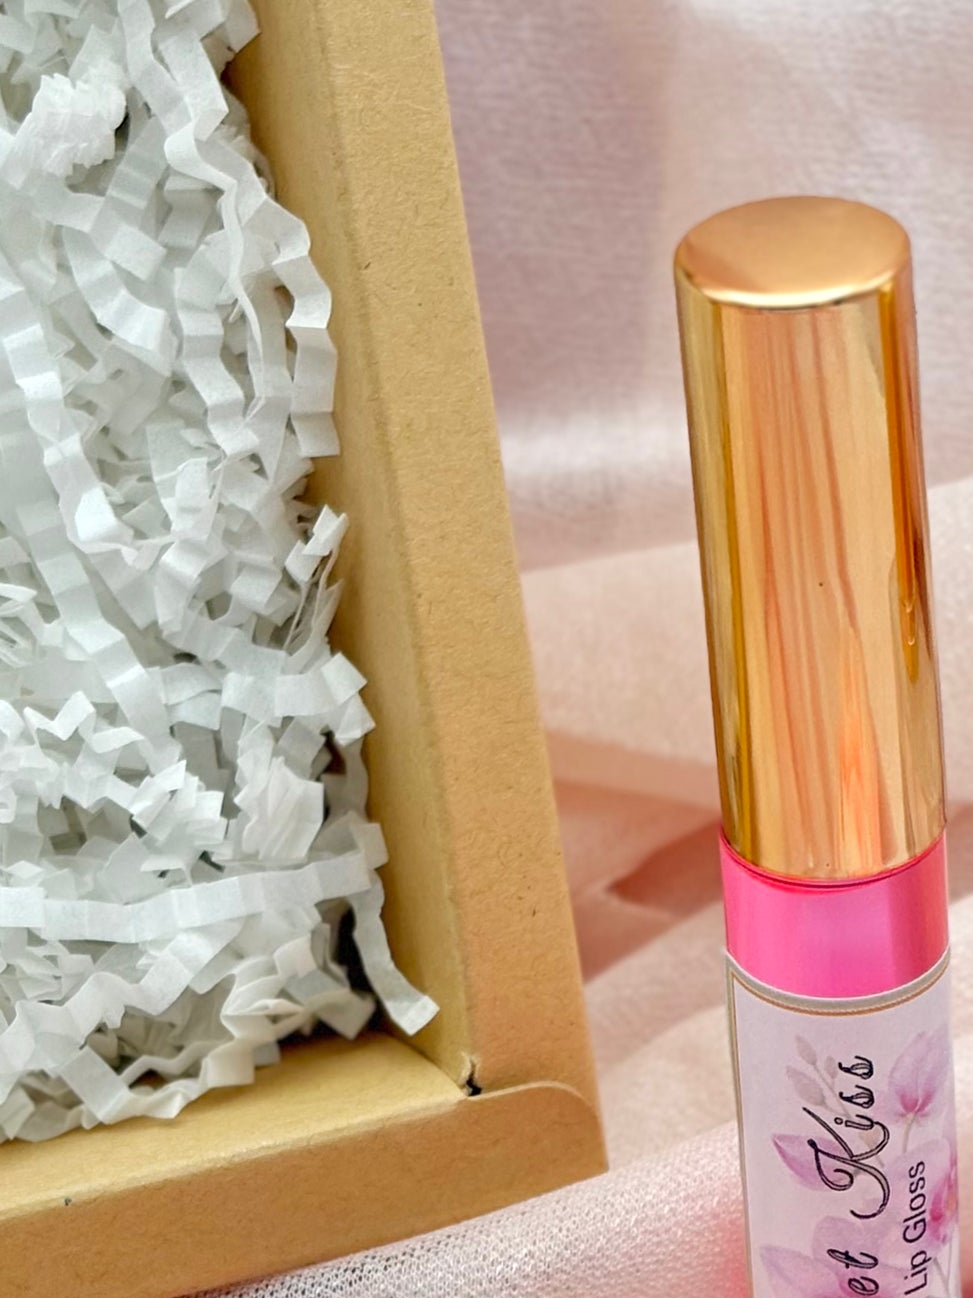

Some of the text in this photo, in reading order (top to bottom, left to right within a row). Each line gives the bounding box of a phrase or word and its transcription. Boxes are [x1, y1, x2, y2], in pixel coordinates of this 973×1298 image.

[802, 1055, 890, 1219] Kiss
[903, 1160, 932, 1296] Lip Gloss
